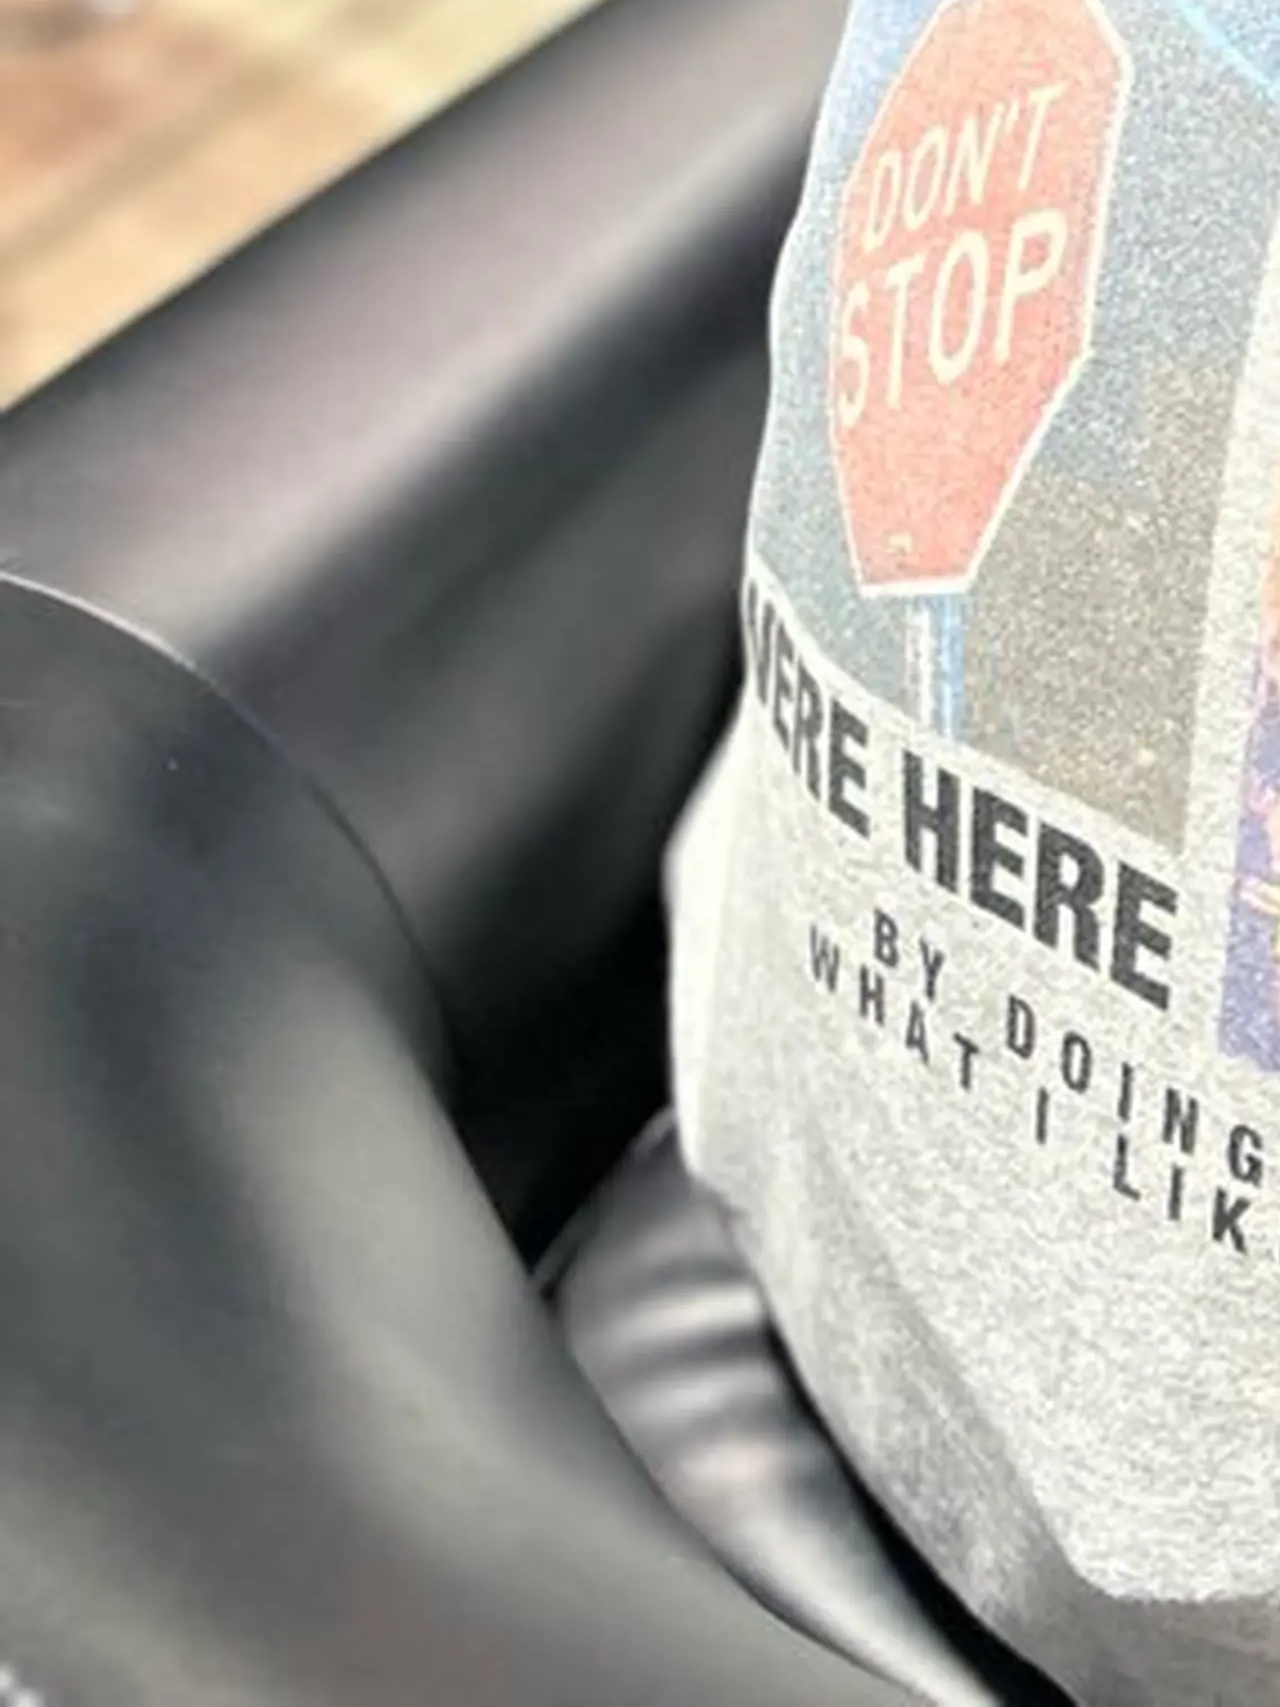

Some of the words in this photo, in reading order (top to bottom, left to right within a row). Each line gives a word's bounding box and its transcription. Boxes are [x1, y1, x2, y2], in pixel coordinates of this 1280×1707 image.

[860, 84, 1071, 254] DON'T
[837, 206, 1069, 427] STOP
[902, 748, 1178, 1011] HERE
[809, 924, 979, 1091] WHAT
[1036, 1088, 1049, 1144] I
[873, 907, 943, 999] BY
[1005, 994, 1264, 1187] DOING
